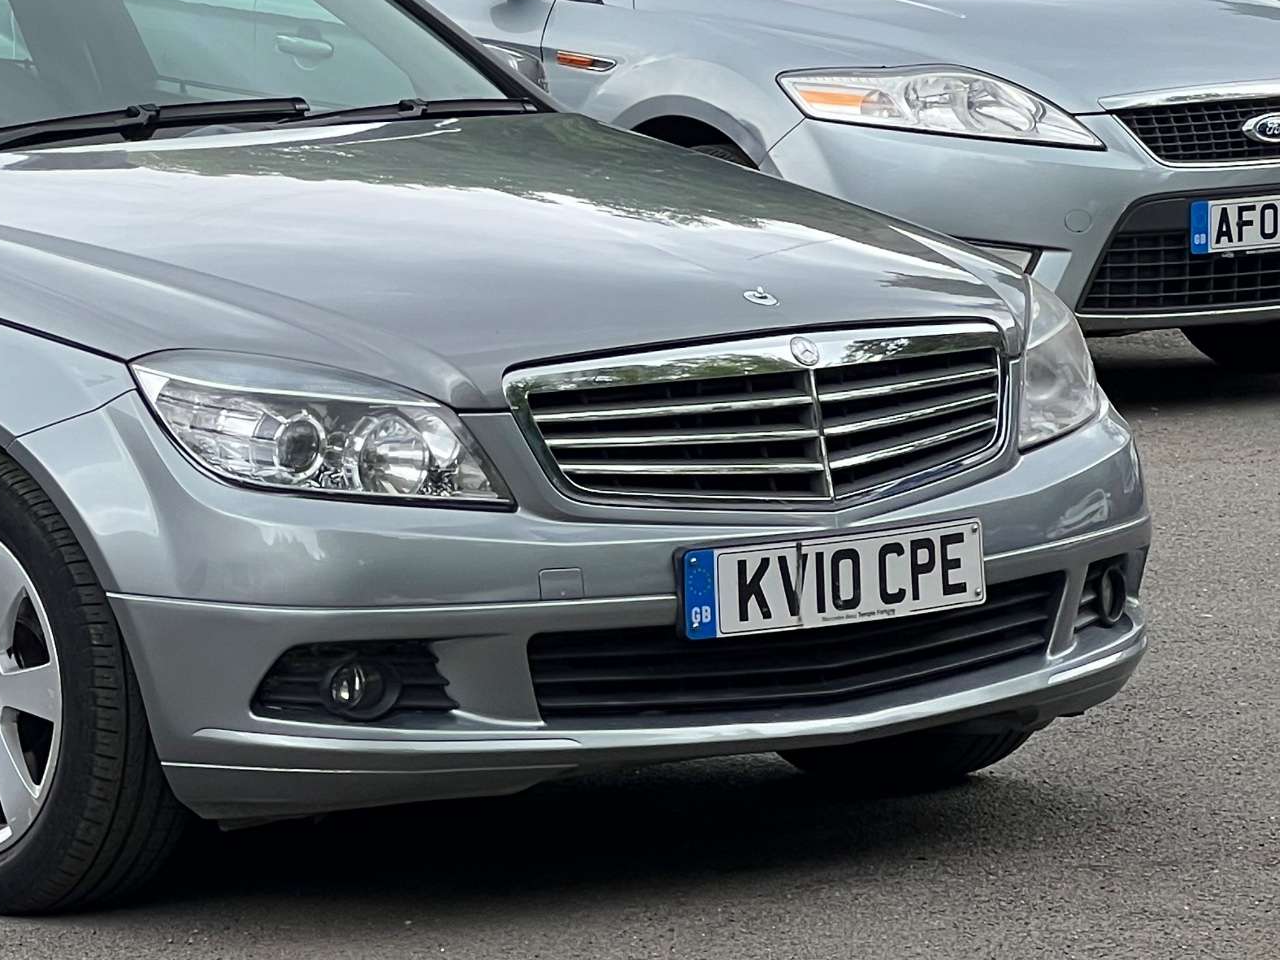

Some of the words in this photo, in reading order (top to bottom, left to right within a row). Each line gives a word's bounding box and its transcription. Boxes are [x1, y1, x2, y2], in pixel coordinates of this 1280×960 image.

[1194, 233, 1206, 245] GB
[737, 548, 861, 622] KV10
[878, 532, 967, 605] CPE
[691, 605, 711, 624] GB
